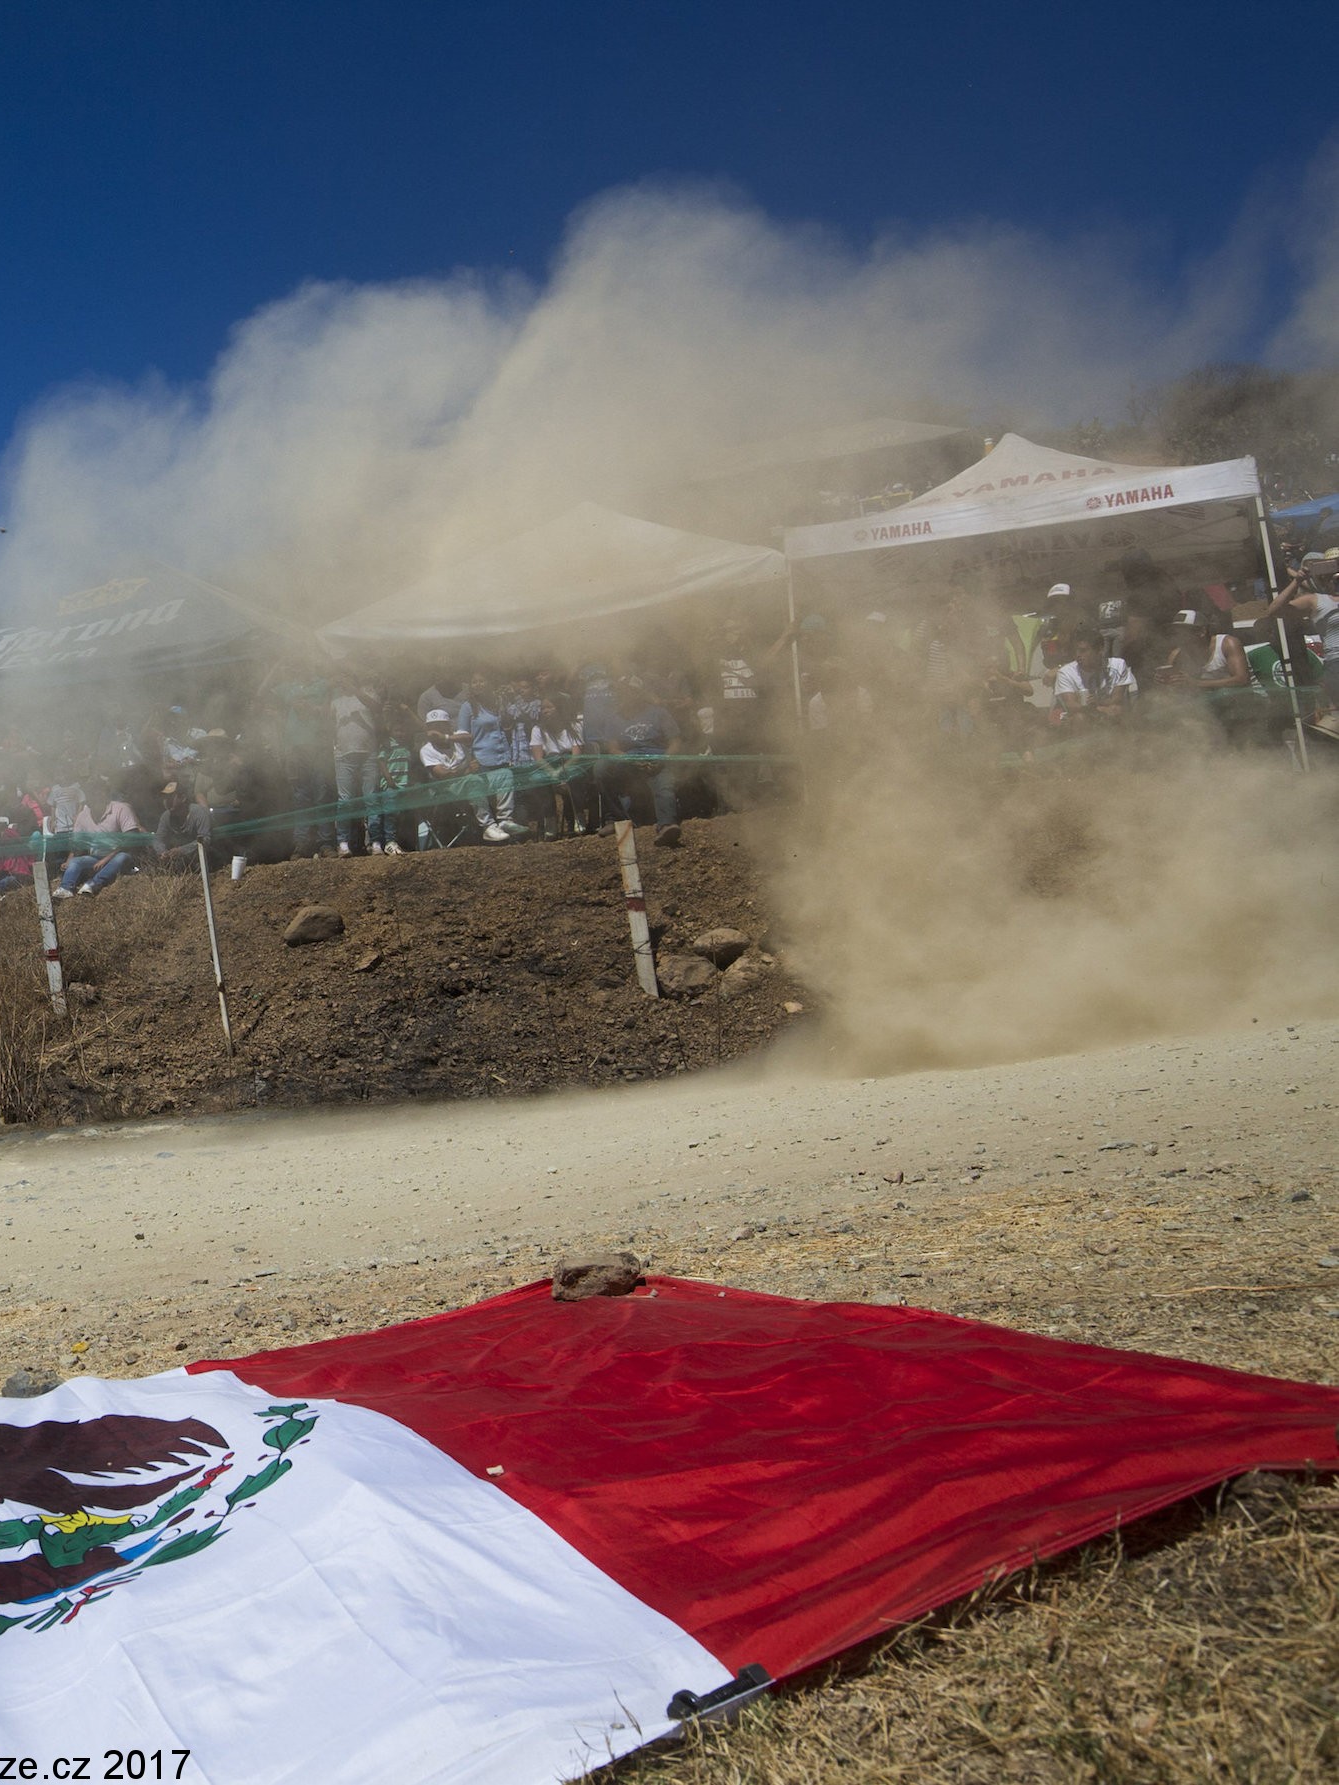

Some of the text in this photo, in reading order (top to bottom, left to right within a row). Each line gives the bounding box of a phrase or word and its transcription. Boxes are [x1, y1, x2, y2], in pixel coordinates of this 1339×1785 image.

[952, 467, 1116, 498] YAMAHA
[1104, 484, 1175, 508] YAMAHA
[870, 521, 933, 541] YAMAHA
